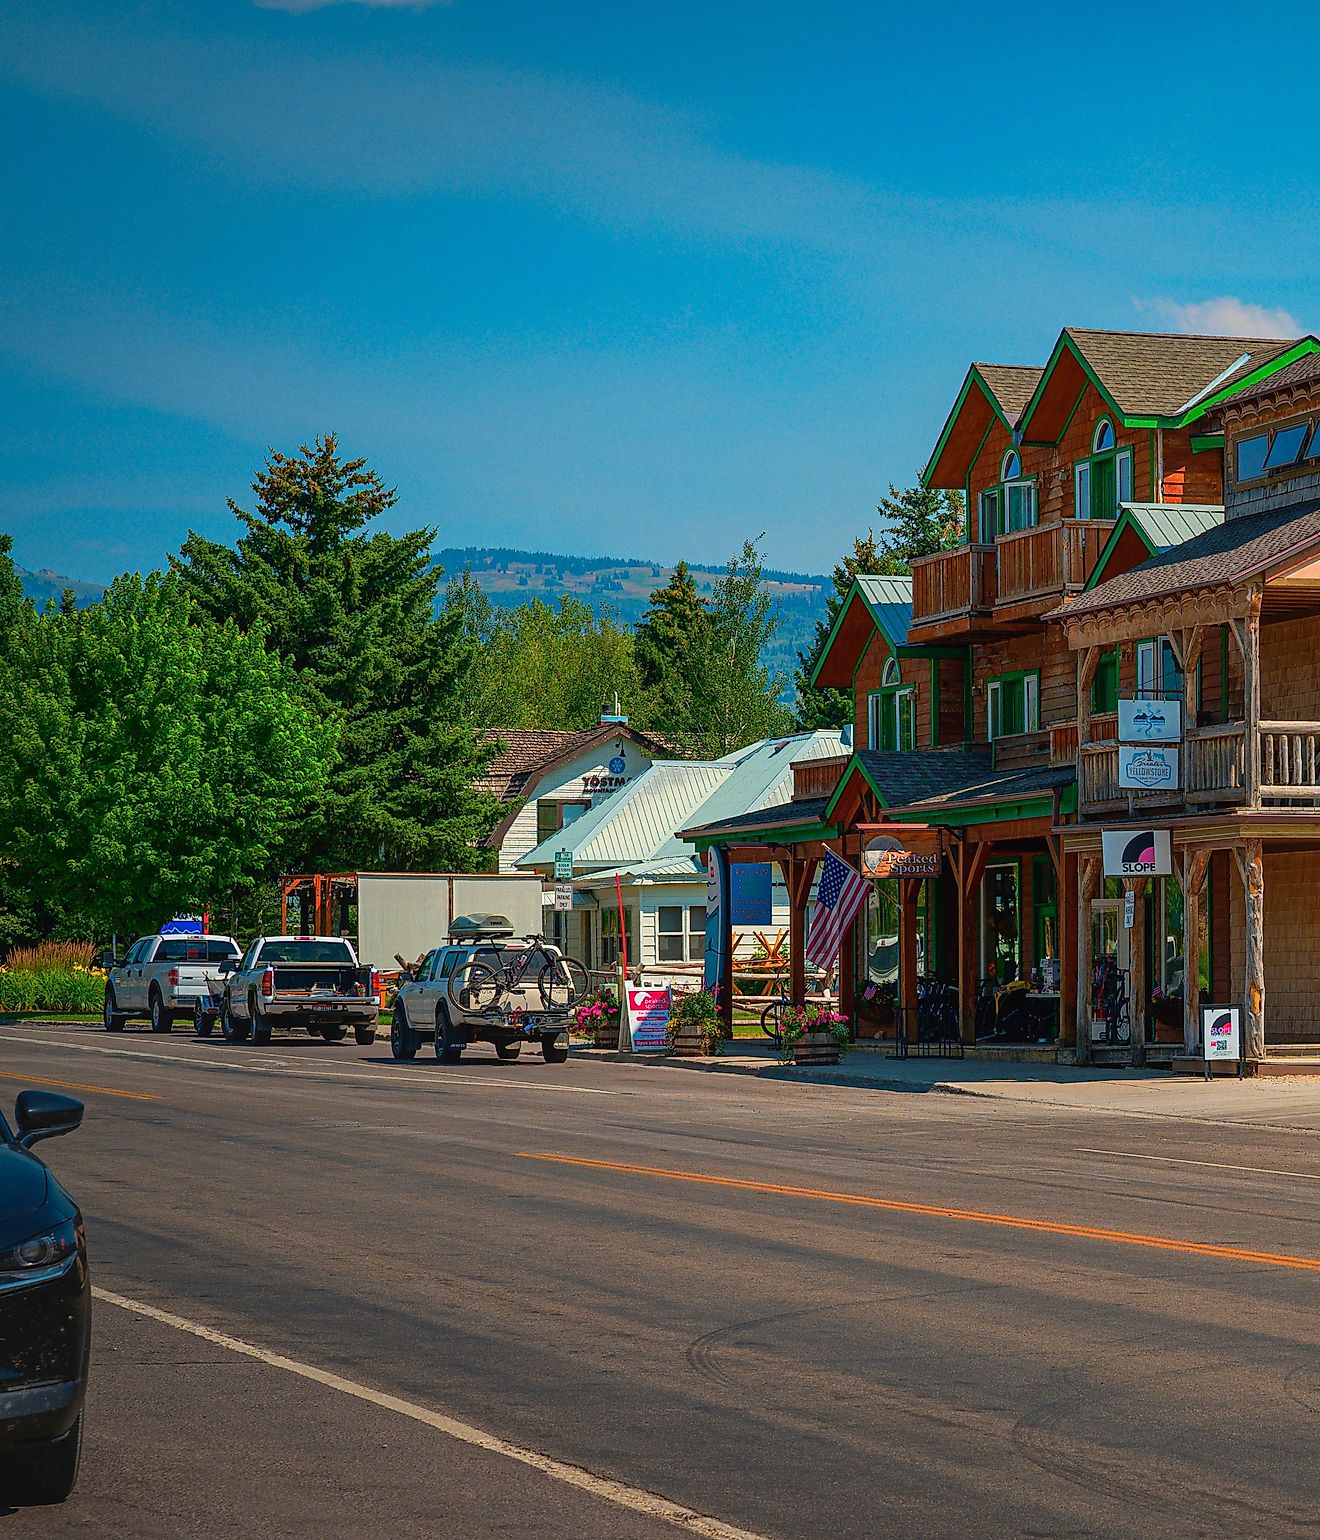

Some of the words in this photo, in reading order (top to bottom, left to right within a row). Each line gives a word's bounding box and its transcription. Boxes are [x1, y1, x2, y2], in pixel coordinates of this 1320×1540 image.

[1129, 767, 1169, 777] YELLOWSTONE
[886, 853, 937, 864] Peaked
[890, 863, 934, 874] Sports
[1122, 862, 1156, 873] SLOPE
